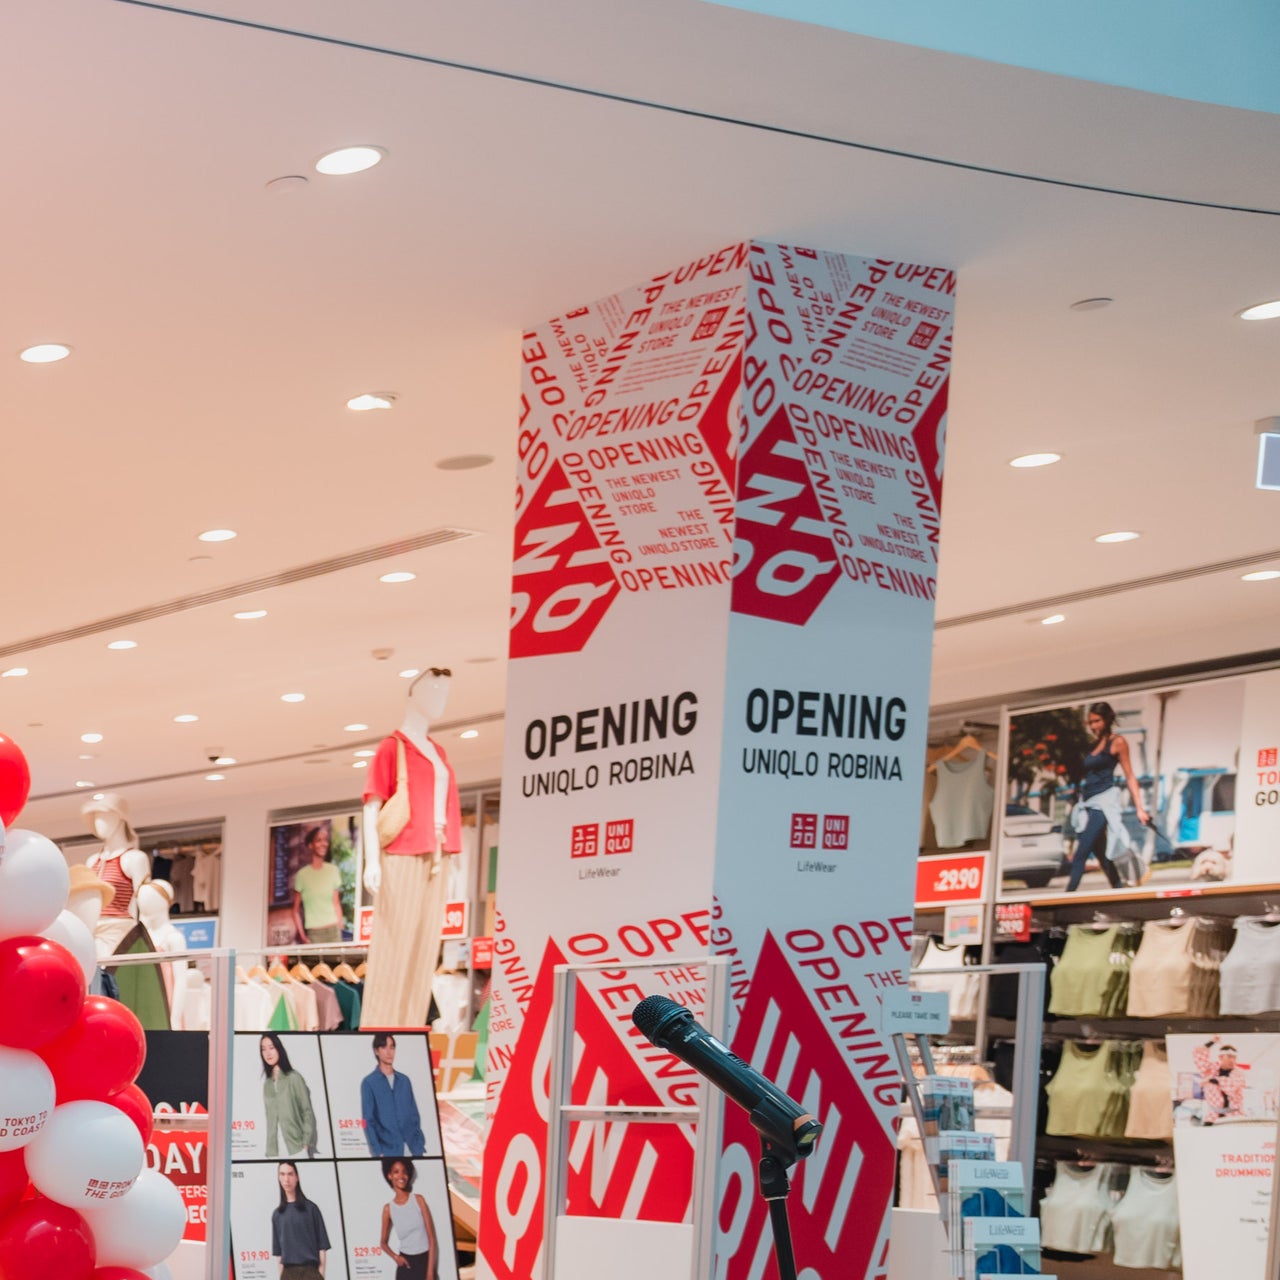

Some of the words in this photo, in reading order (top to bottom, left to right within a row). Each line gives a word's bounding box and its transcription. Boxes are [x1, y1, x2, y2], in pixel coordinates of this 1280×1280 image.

[659, 299, 684, 317] THE
[684, 285, 741, 311] NEWEST
[880, 292, 906, 311] THE
[904, 297, 951, 321] NEWEST
[648, 313, 694, 335] UNIQLO
[870, 306, 910, 329] UNIQLO
[861, 321, 897, 341] STORE
[637, 334, 679, 353] STORE
[793, 367, 896, 418] OPENING
[566, 397, 680, 442] OPENING
[813, 410, 916, 464] OPENING
[587, 433, 704, 472] OPENING
[789, 403, 854, 548] OPENING
[832, 450, 854, 467] THE
[854, 456, 898, 481] NEWEST
[606, 477, 630, 489] THE
[632, 469, 681, 486] NEWEST
[836, 468, 876, 490] UNIQLO
[612, 488, 655, 504] UNIQLO
[841, 484, 877, 506] STORE
[562, 452, 632, 565] OPENING
[619, 502, 656, 516] STORE
[677, 510, 703, 522] THE
[658, 523, 709, 540] NEWEST
[893, 513, 915, 530] THE
[876, 523, 920, 546] NEWEST
[524, 690, 699, 760] OPENING
[746, 688, 908, 741] OPENING
[522, 764, 599, 798] UNIQLO
[609, 750, 695, 786] ROBINA
[742, 748, 818, 779] UNIQLO
[827, 753, 903, 781] ROBINA
[578, 866, 621, 880] LifeWear
[797, 860, 837, 873] LifeWear
[654, 966, 706, 986] THE
[865, 968, 908, 988] THE
[891, 1011, 913, 1020] PLEASE
[914, 1012, 928, 1020] TAKE
[4, 1116, 35, 1127] TOKYO
[1216, 1168, 1272, 1178] DRUMMING
[85, 1188, 108, 1199] THE
[241, 1251, 270, 1261] $19.90
